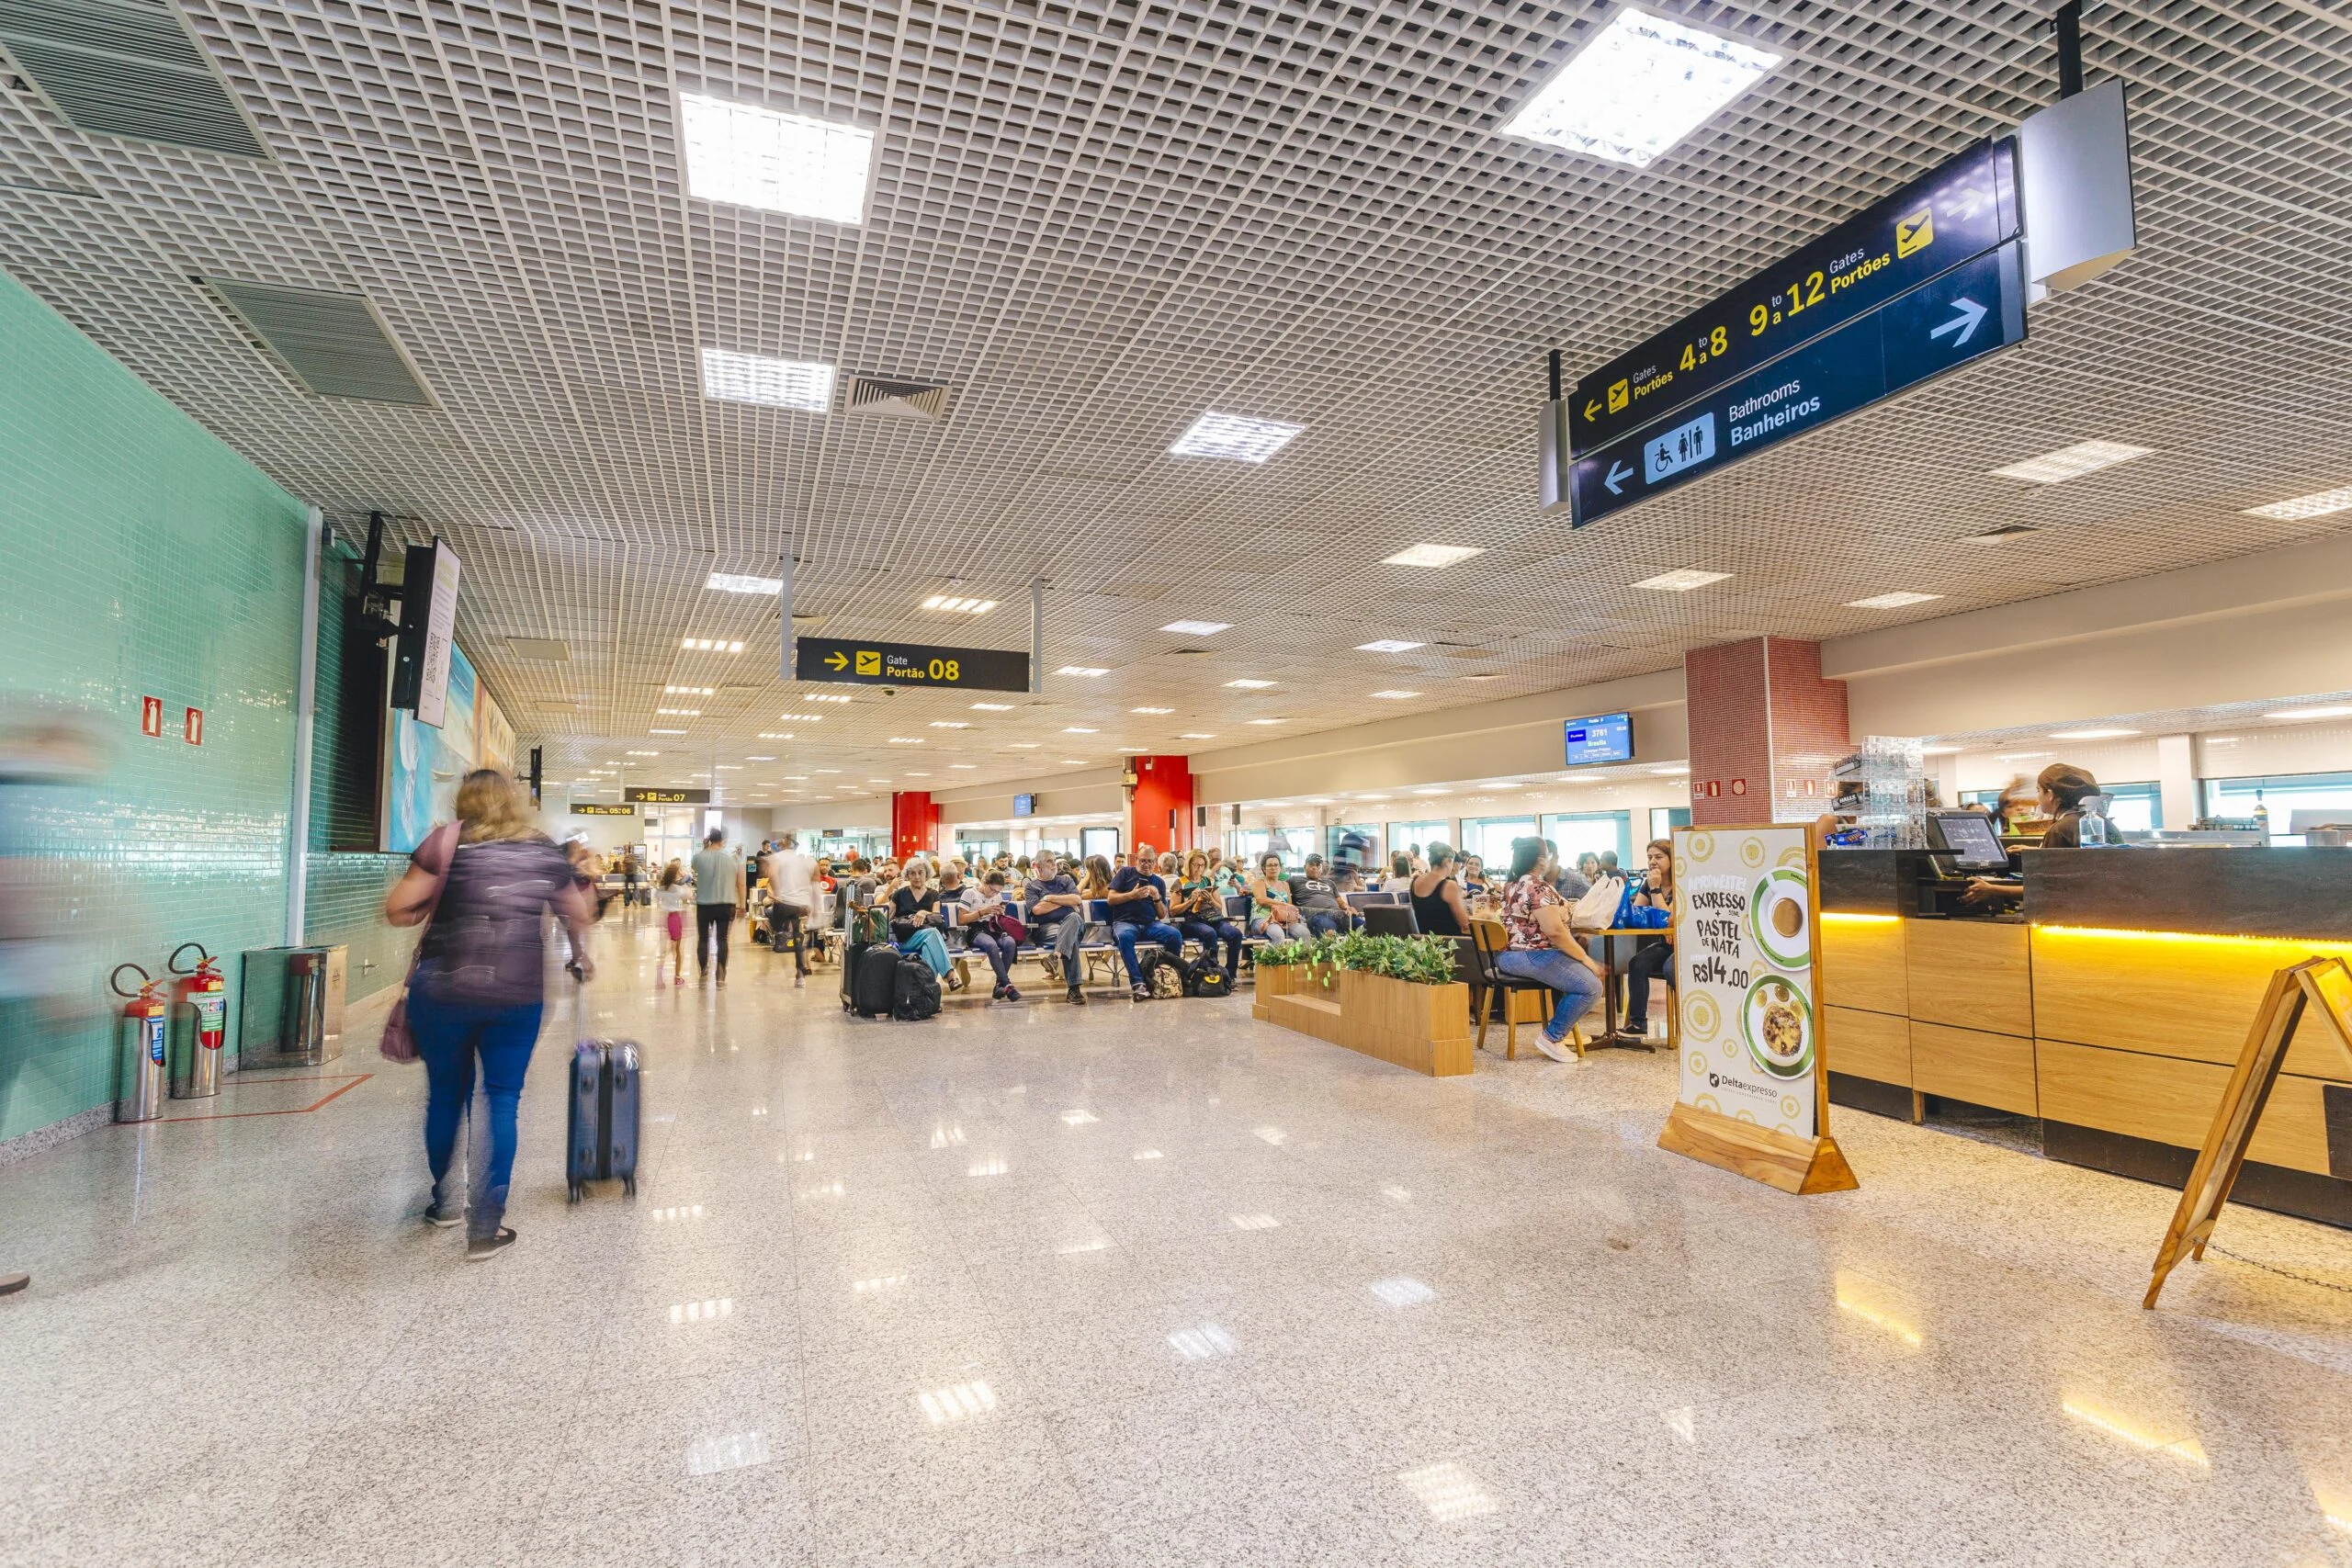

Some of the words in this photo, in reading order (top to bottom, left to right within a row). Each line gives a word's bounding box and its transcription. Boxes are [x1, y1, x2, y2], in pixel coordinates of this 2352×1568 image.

[1829, 248, 1865, 274] Gates
[1772, 311, 1781, 324] a
[1831, 253, 1891, 294] Portões
[1749, 304, 1768, 336] 9
[1771, 295, 1782, 307] to
[1786, 271, 1826, 317] 12
[1679, 344, 1696, 371] 4
[1698, 337, 1708, 348] to
[1711, 325, 1727, 356] 8
[1633, 366, 1657, 384] Gates
[1634, 371, 1673, 400] Portões
[1699, 352, 1707, 364] a
[1729, 379, 1801, 423] Bathrooms
[1730, 396, 1821, 447] Banheiros
[887, 655, 908, 665] Gate
[887, 666, 925, 679] Portão
[929, 659, 959, 681] 08
[673, 794, 685, 802] 07
[1839, 795, 1856, 803] HALLS
[1692, 892, 1746, 911] EXPRESSO
[1697, 919, 1741, 941] PASTEL
[1702, 938, 1710, 947] DE
[1711, 938, 1740, 959] NATA
[1722, 1076, 1778, 1098] Deltaexpresso
